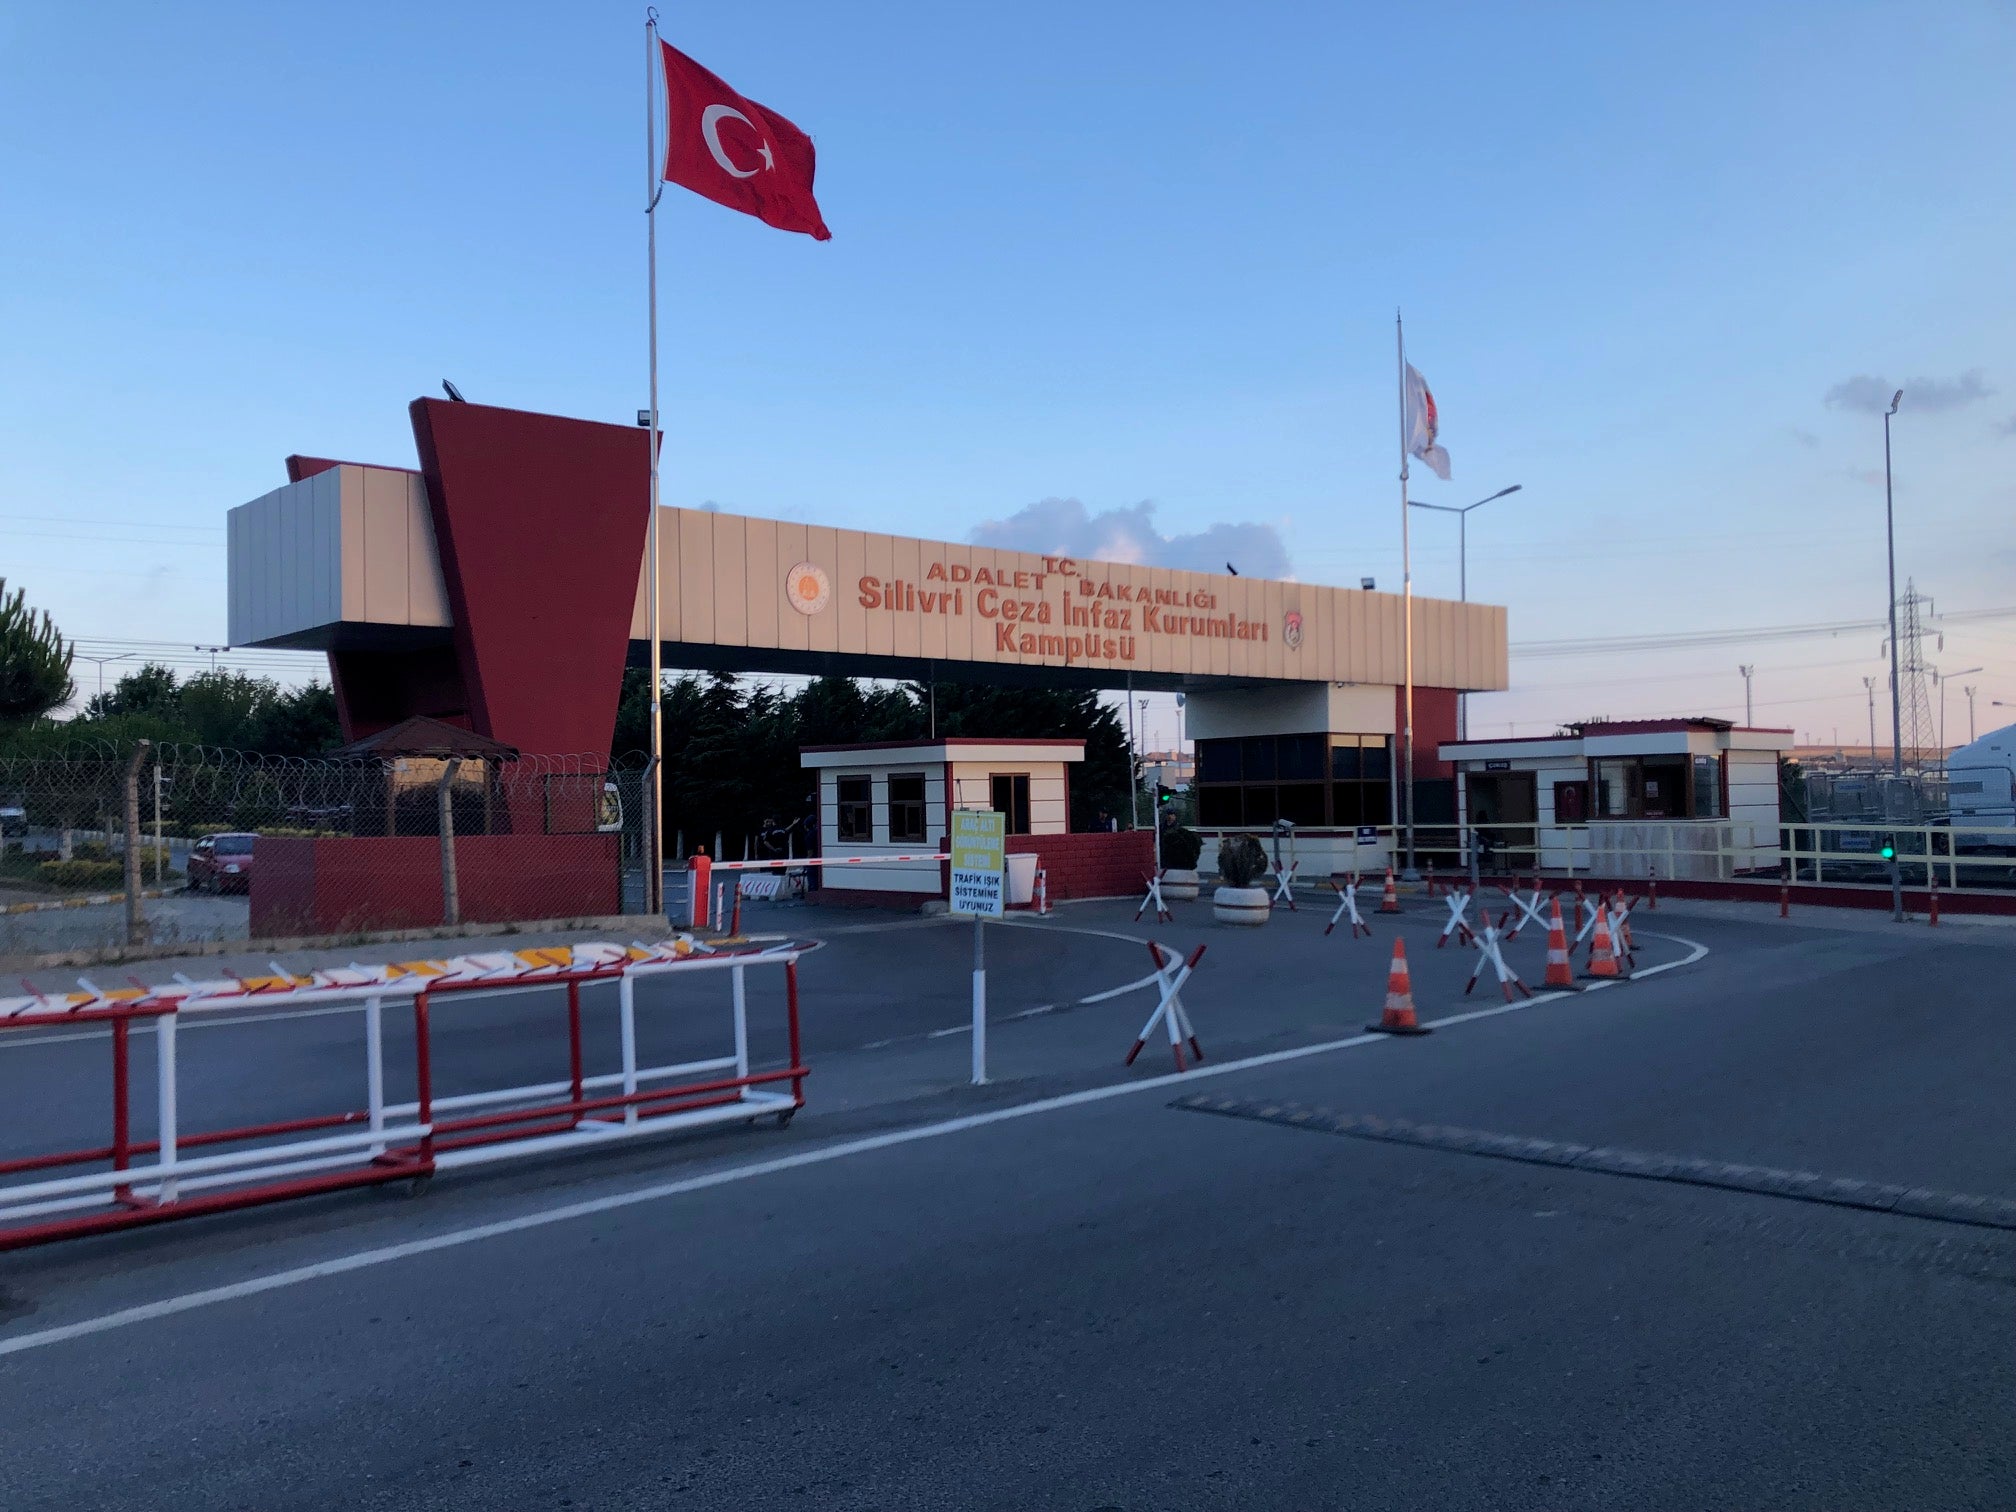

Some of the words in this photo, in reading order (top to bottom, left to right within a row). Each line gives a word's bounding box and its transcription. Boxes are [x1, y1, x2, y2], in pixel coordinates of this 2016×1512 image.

[927, 562, 1047, 590] ADALET
[1079, 579, 1217, 609] BAKANLIĞI
[858, 576, 963, 615] Silivri
[977, 588, 1051, 624] Ceza
[1063, 590, 1132, 630] İnfaz
[1143, 605, 1269, 641] Kurumları
[996, 622, 1136, 664] Kampüsü
[954, 872, 982, 884] TRAFİK
[984, 876, 1000, 887] IŞIK
[955, 886, 999, 900] SİSTEMİNE
[959, 900, 994, 912] UYUNUZ
